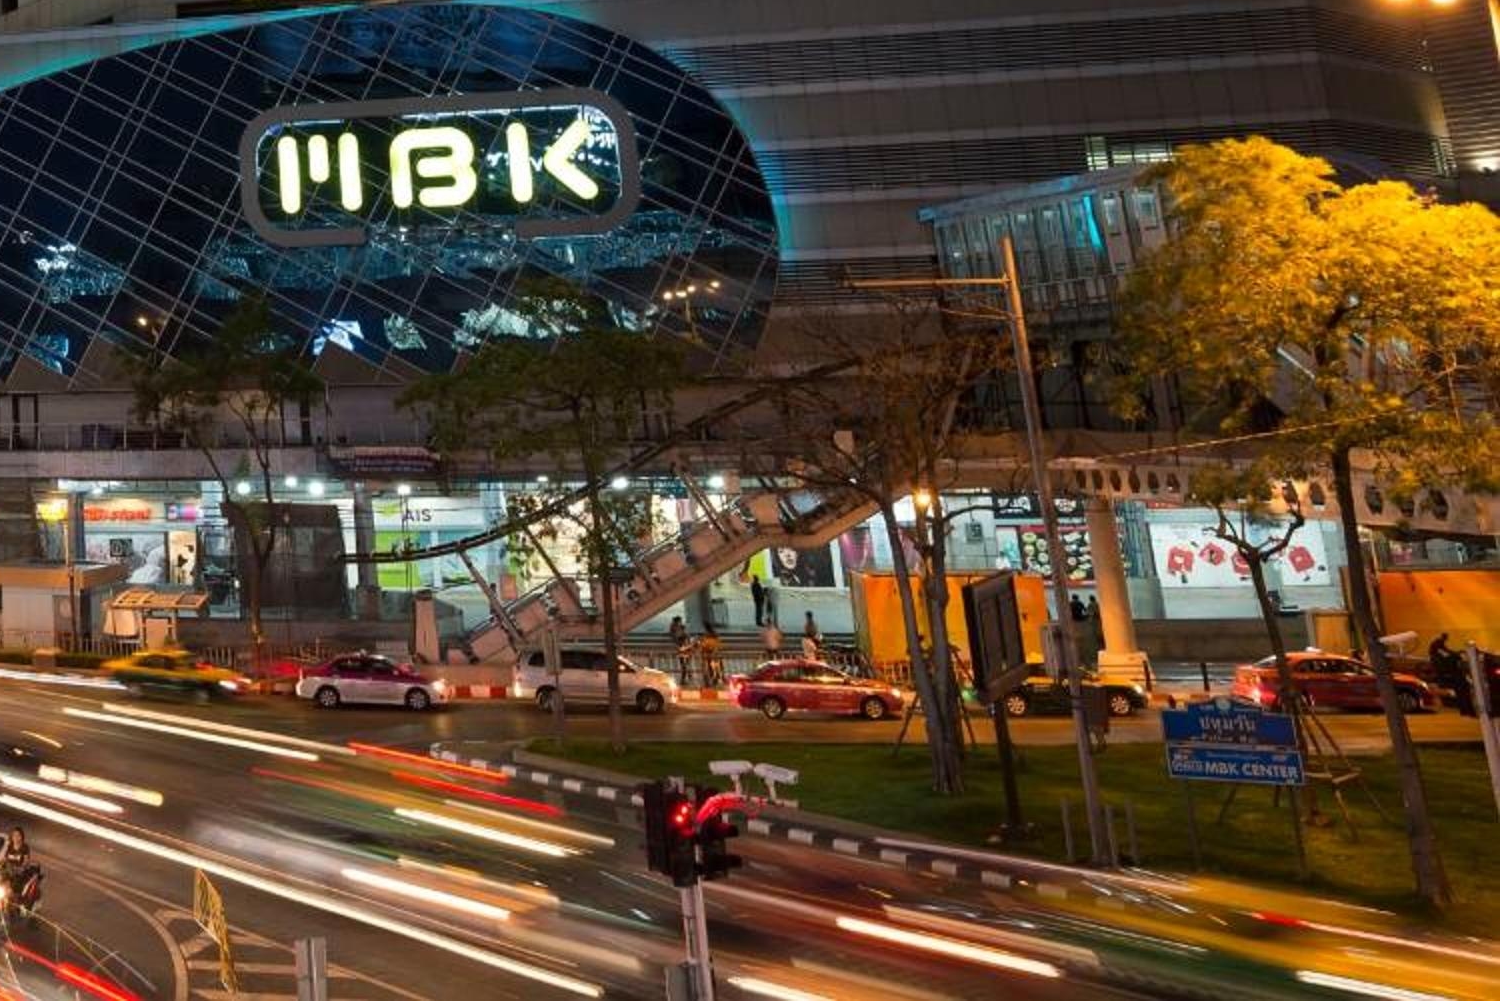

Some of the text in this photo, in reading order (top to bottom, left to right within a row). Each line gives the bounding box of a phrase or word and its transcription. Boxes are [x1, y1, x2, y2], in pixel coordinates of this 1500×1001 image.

[277, 117, 600, 215] MBK
[402, 508, 432, 522] AIS
[1205, 761, 1238, 776] MBK
[1241, 763, 1299, 779] CENTER
